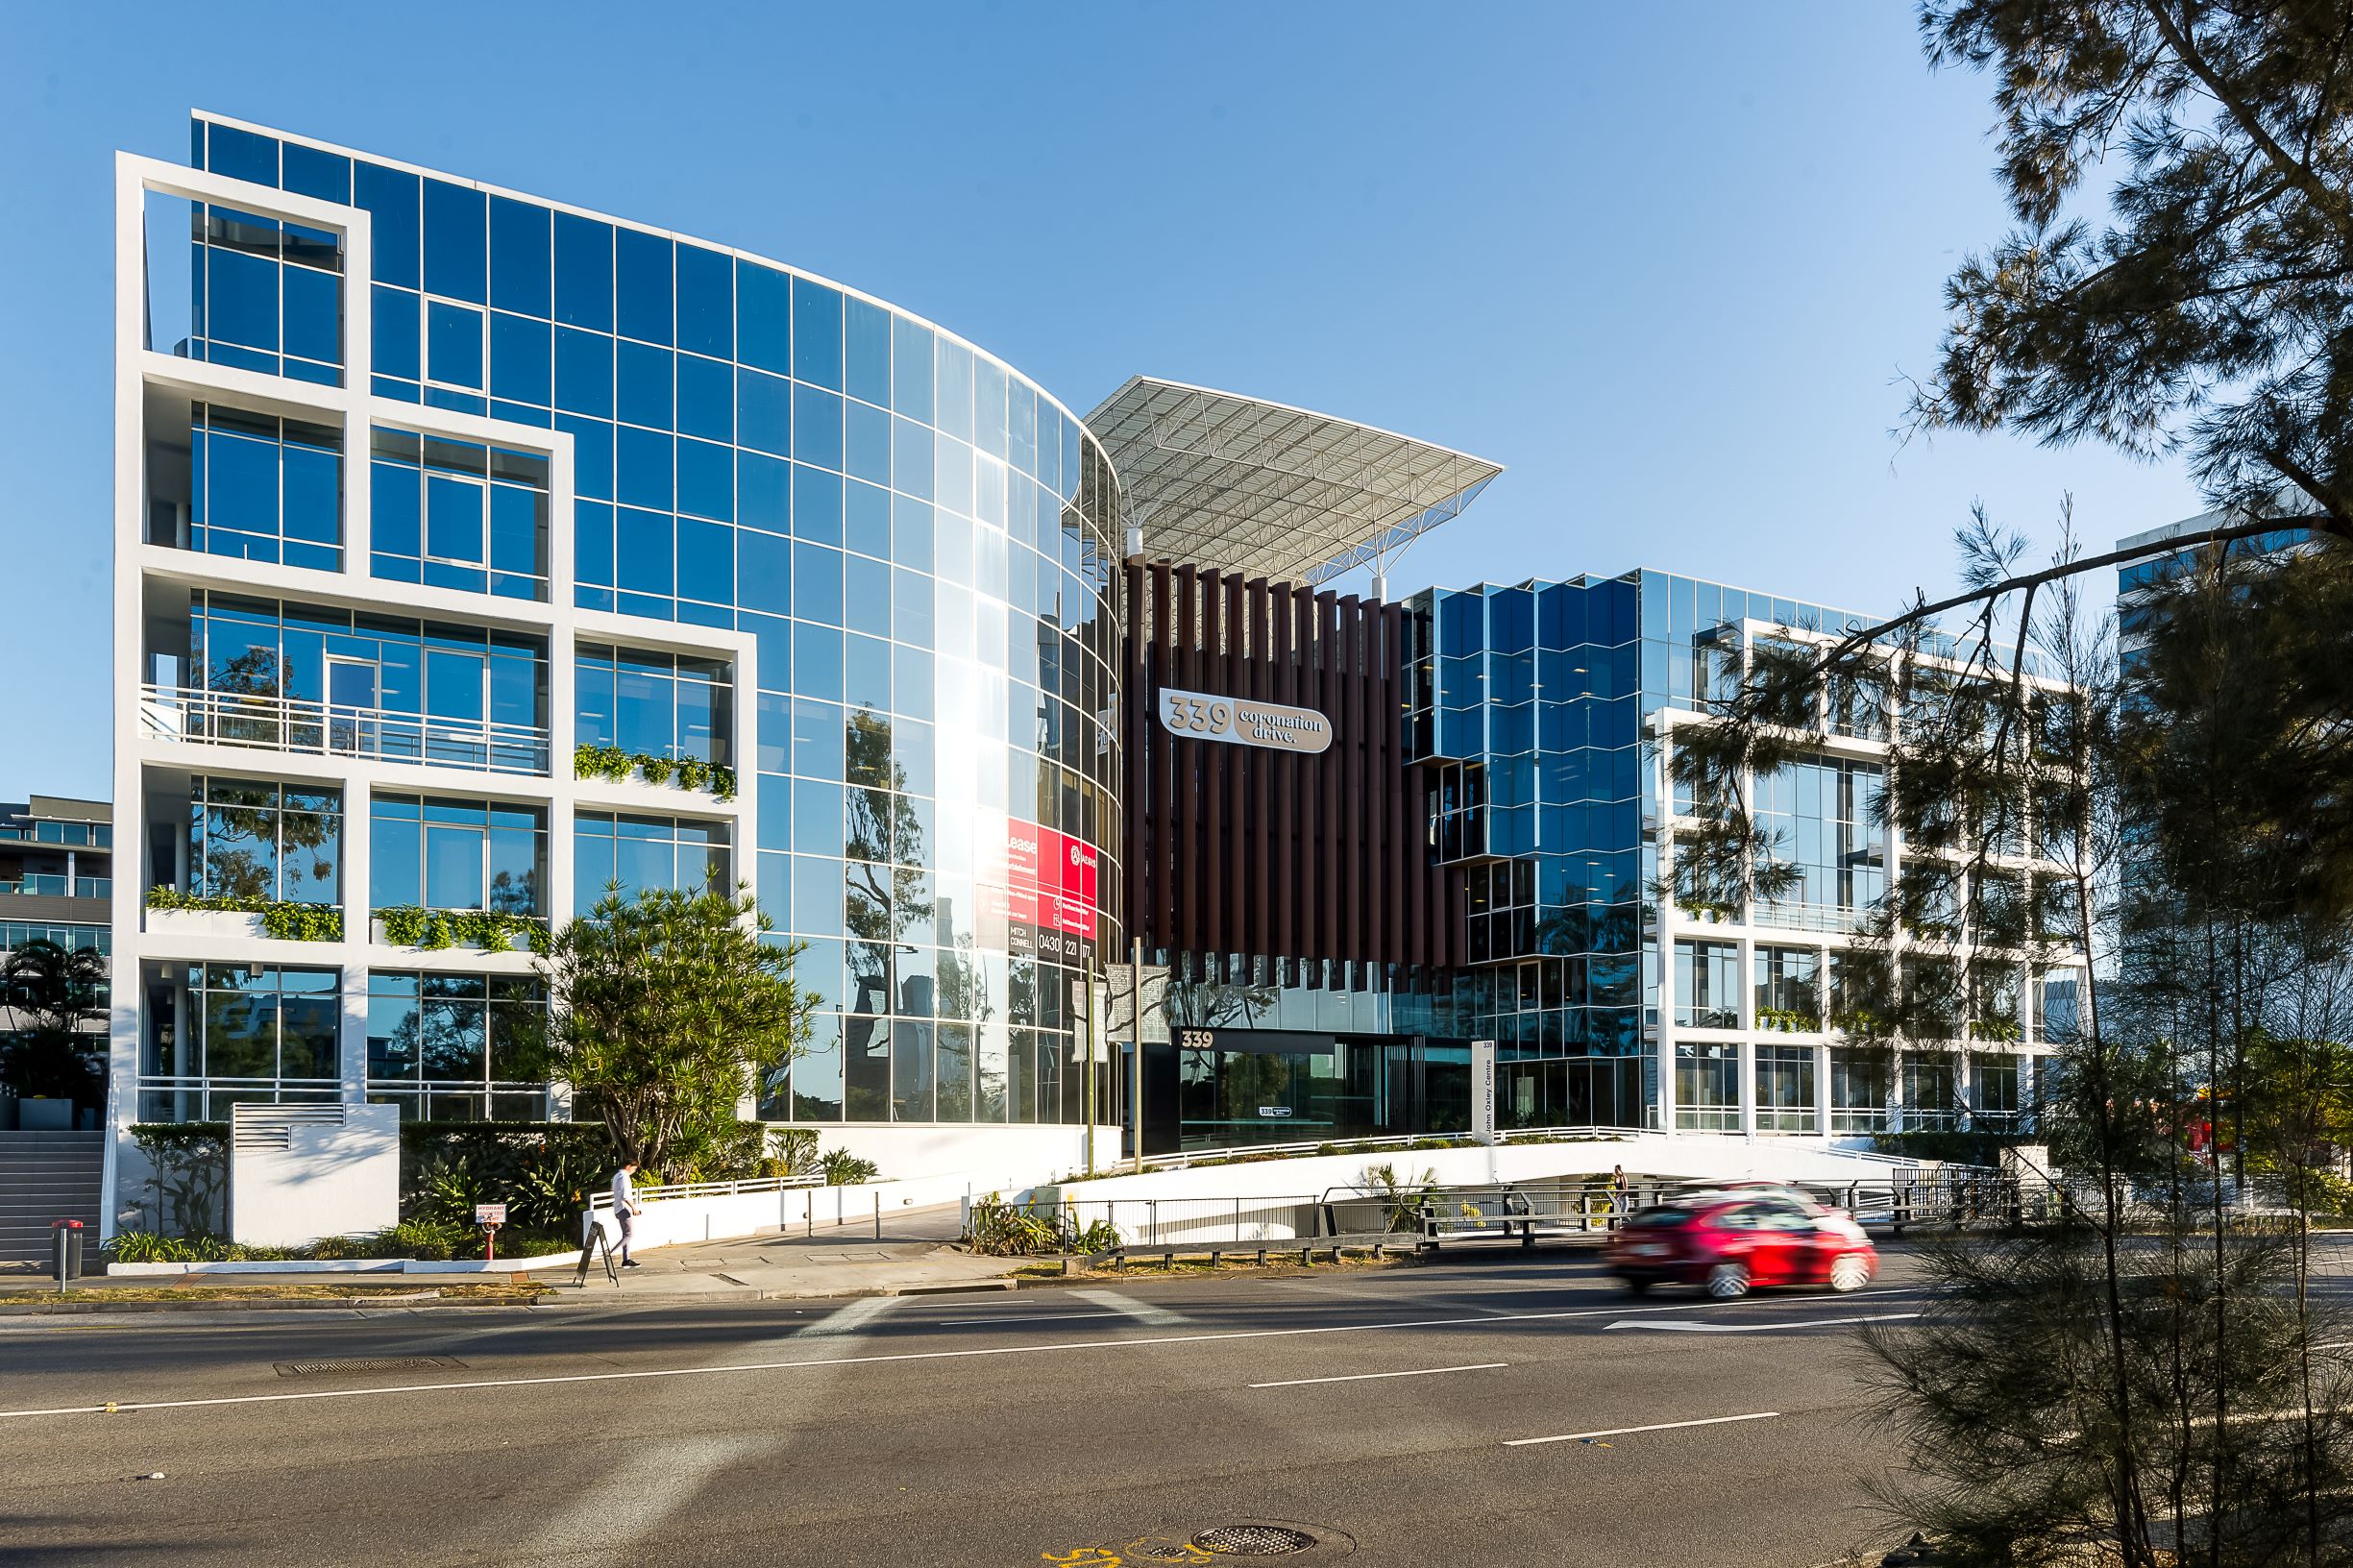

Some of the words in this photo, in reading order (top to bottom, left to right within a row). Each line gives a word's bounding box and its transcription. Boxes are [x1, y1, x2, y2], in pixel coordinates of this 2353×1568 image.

[1169, 696, 1232, 734] 339
[1238, 710, 1323, 732] coronation
[1253, 723, 1297, 744] drive.
[1006, 836, 1037, 855] ease
[1082, 853, 1096, 869] AEGIS
[1010, 926, 1027, 937] MITCH
[1010, 937, 1034, 949] CONNELL
[1039, 934, 1060, 952] 0430
[1065, 940, 1077, 956] 221
[1182, 1030, 1213, 1047] 339
